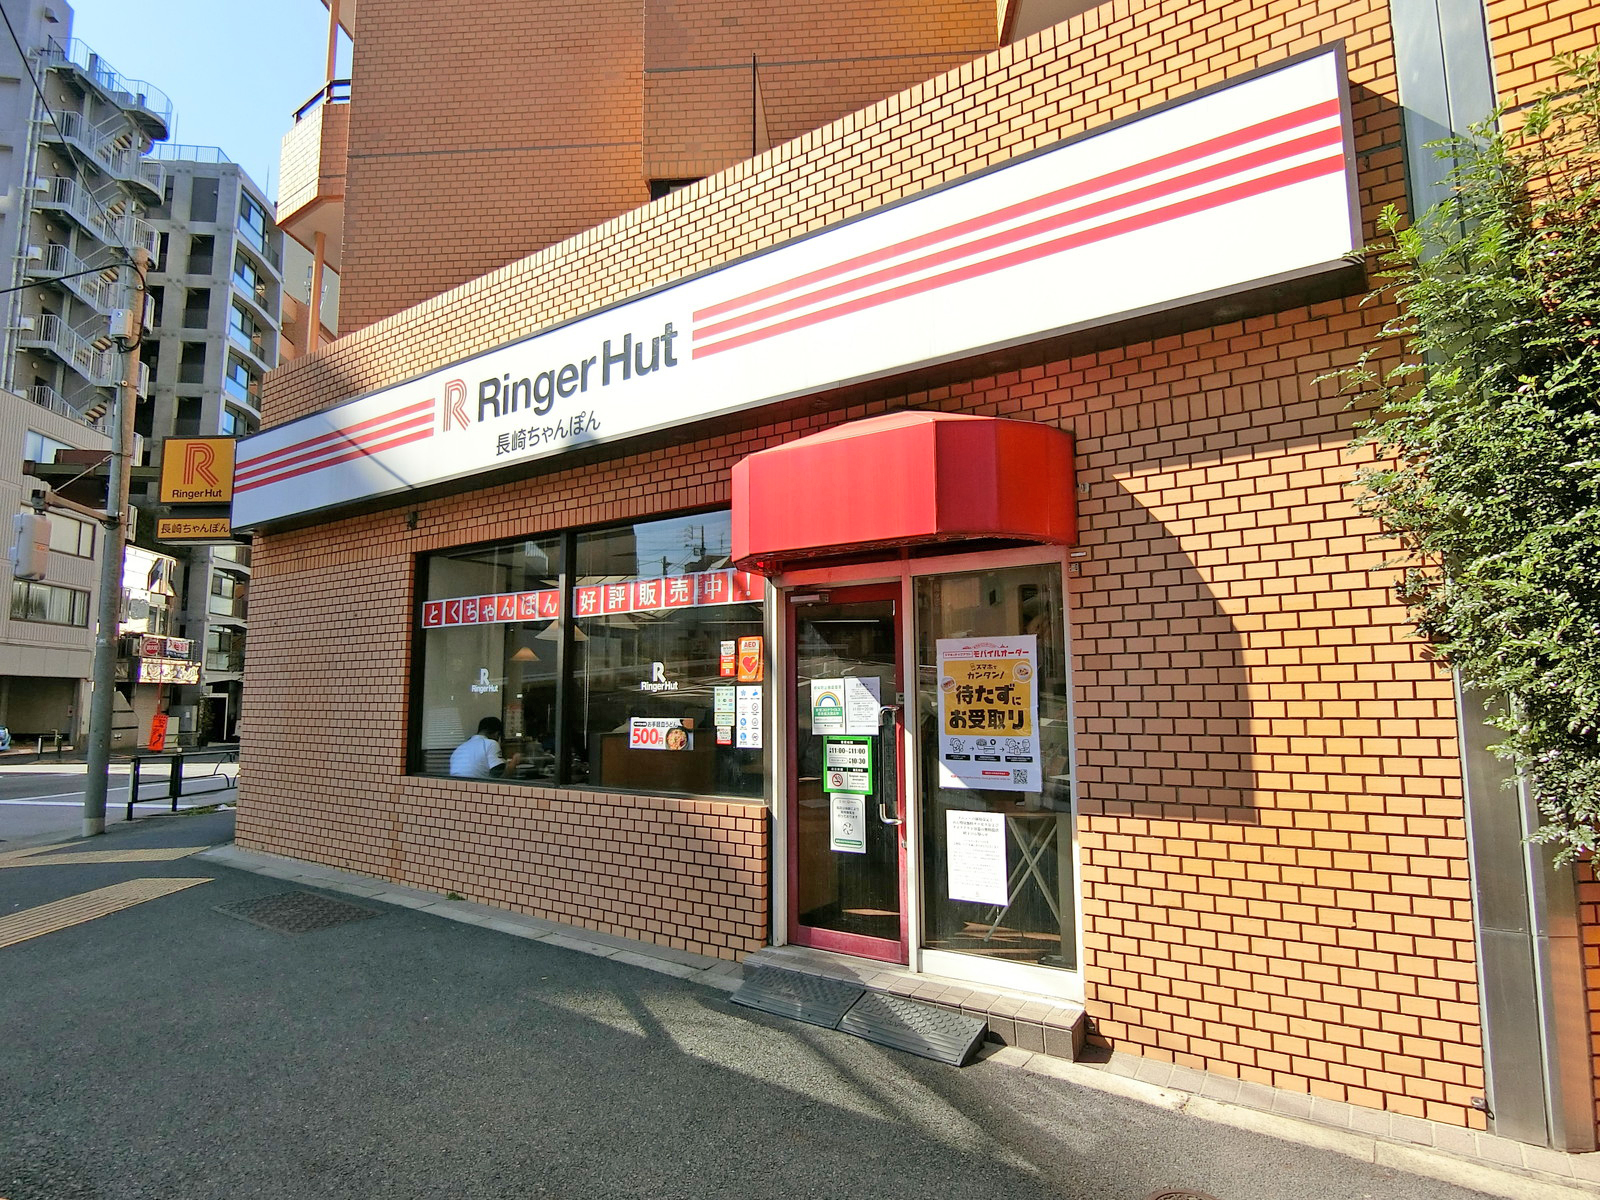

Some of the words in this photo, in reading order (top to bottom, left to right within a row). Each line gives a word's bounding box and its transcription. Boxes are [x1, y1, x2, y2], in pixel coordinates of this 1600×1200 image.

[478, 356, 597, 422] Ringer
[602, 322, 678, 387] Hut
[443, 378, 471, 432] R
[495, 410, 601, 456] 長崎ちゃんぽん
[183, 443, 219, 488] R
[172, 489, 204, 499] Ringer
[204, 488, 222, 498] Hut
[161, 523, 229, 534] 長崎ちゃんぽん
[429, 594, 558, 623] とくちゃんぽん
[973, 648, 1030, 658] モバイルオーダー
[480, 668, 490, 686] R
[652, 661, 667, 682] R
[640, 682, 665, 692] Ringer
[664, 681, 679, 690] Hut
[956, 683, 1022, 706] 待たずに
[949, 709, 1024, 730] お受取り
